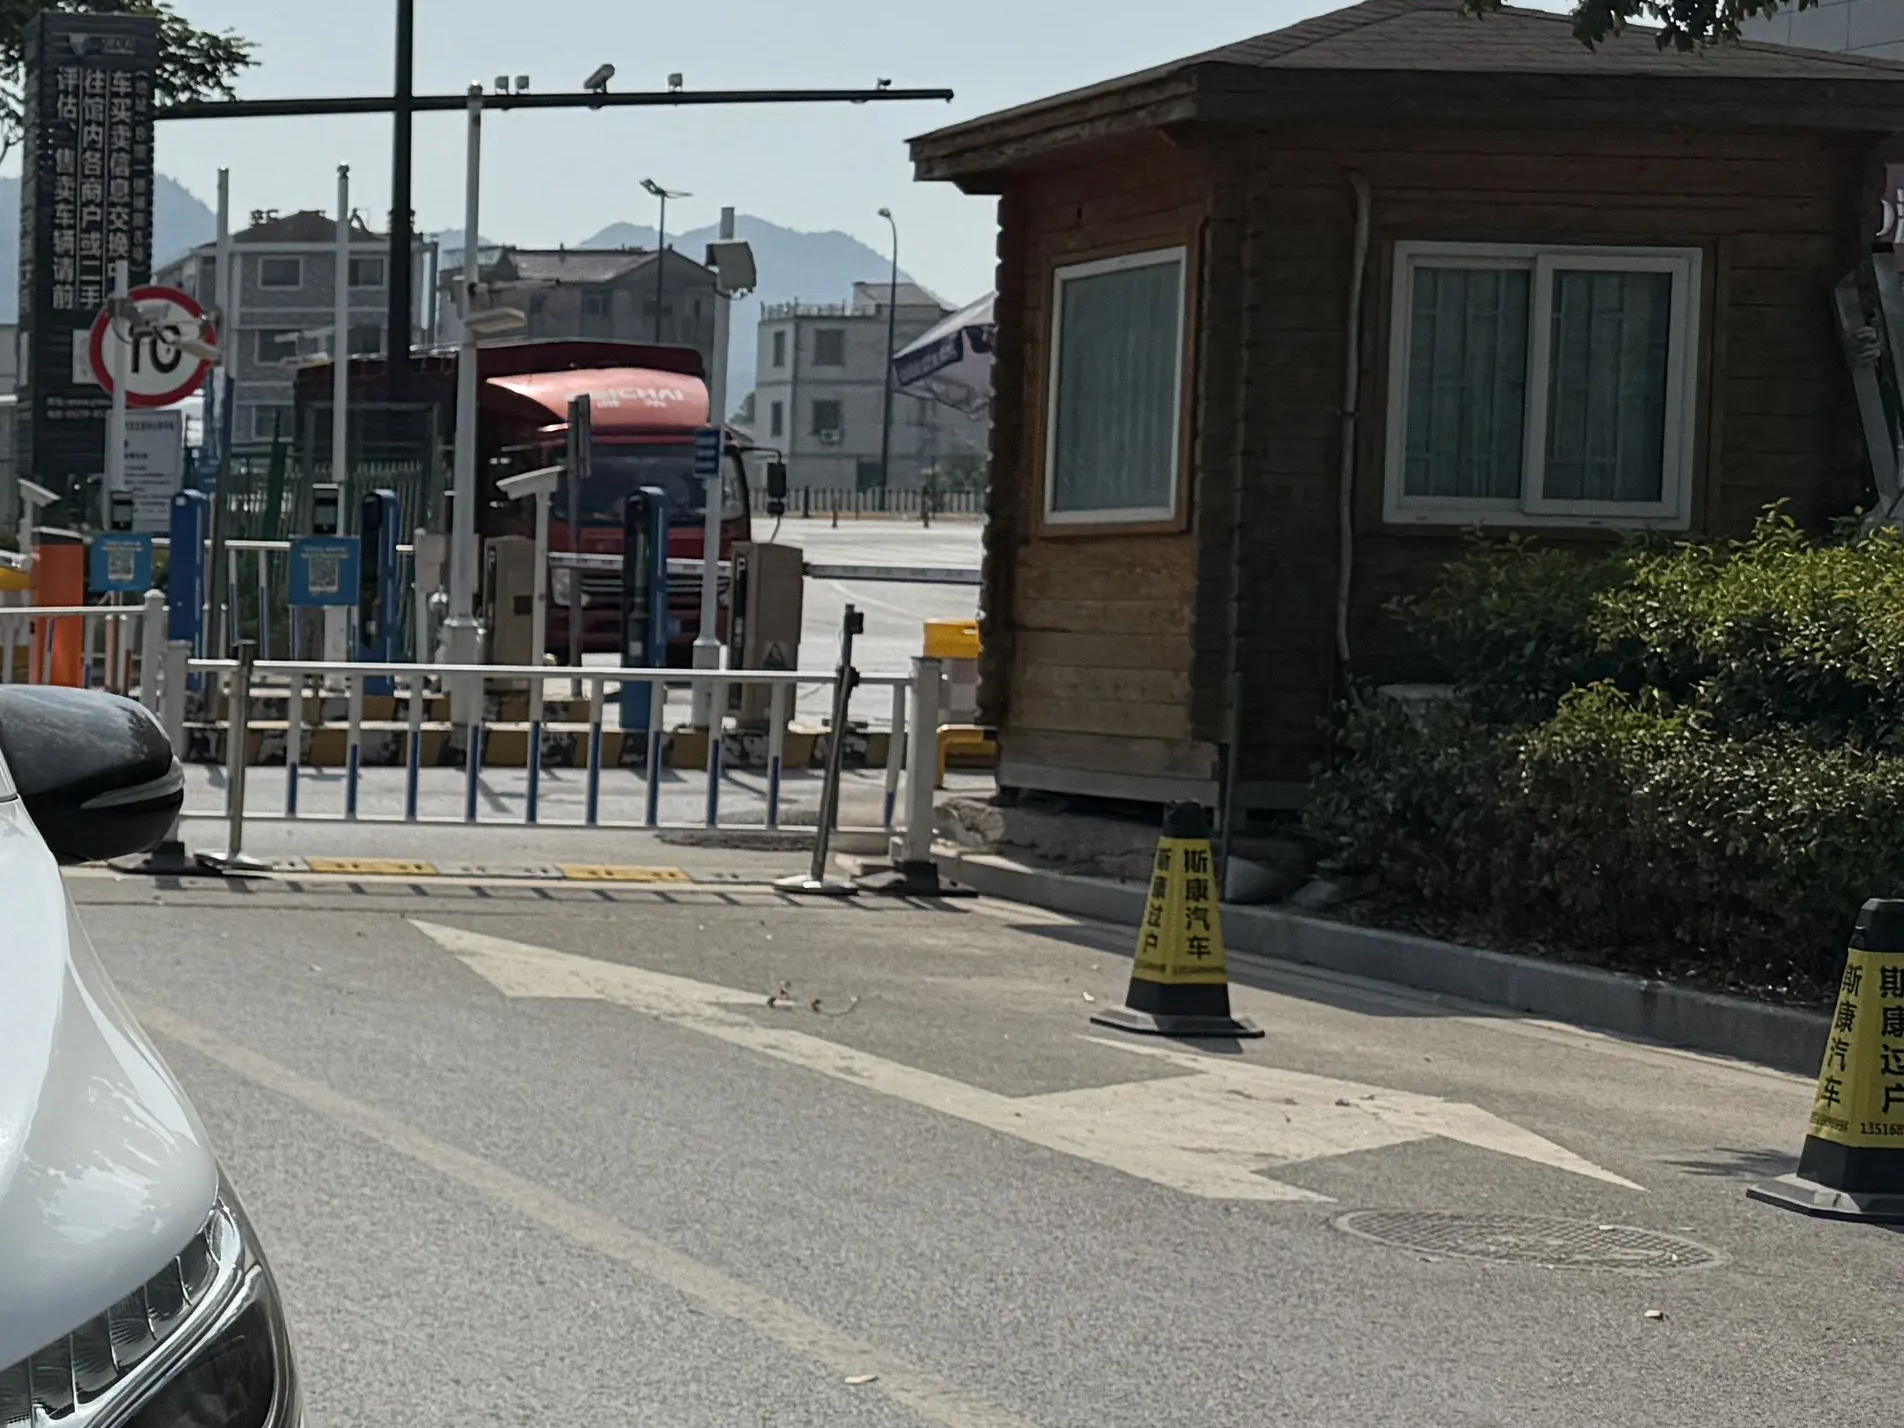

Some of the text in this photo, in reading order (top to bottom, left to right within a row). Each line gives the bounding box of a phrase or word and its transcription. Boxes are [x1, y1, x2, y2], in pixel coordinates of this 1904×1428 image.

[1183, 846, 1211, 960] 斯康汽车
[1821, 963, 1863, 1108] 斯康汽车
